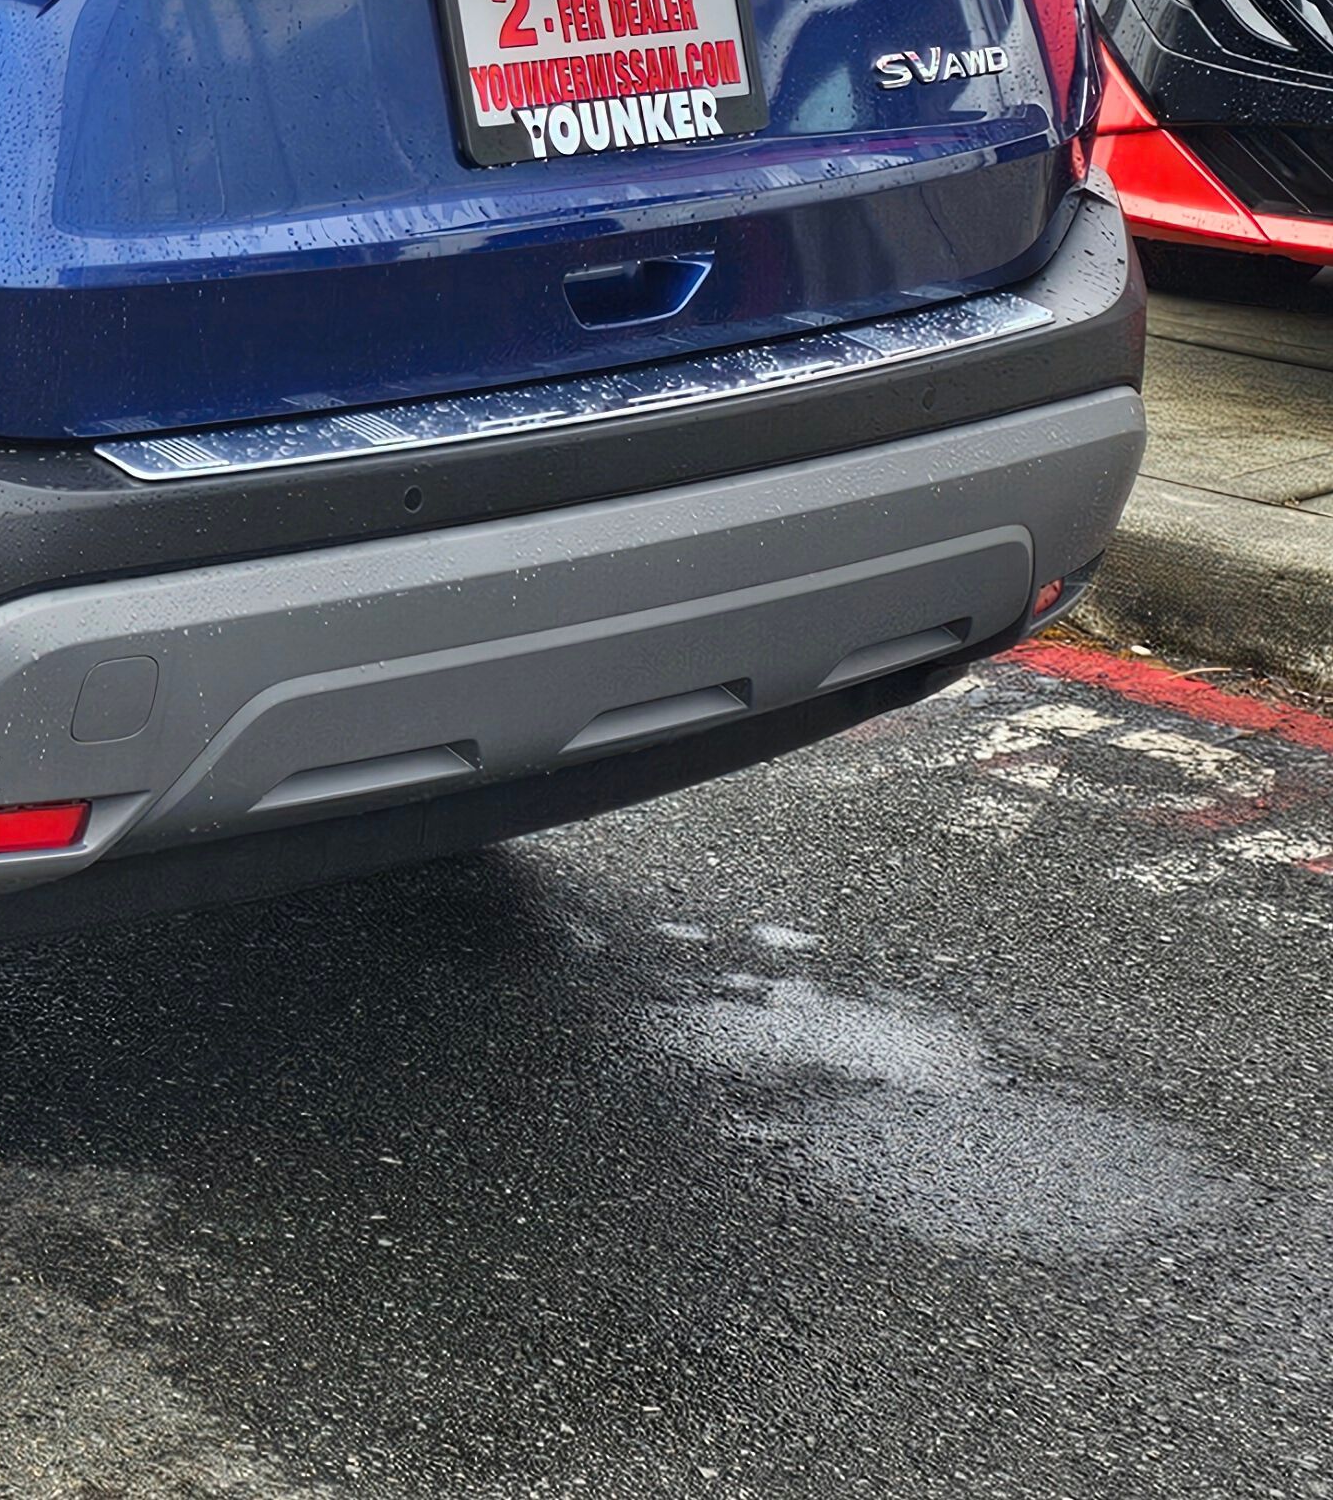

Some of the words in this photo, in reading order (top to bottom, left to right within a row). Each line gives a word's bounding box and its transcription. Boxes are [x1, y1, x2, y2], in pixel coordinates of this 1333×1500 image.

[469, 39, 741, 113] YOUNKERNISSAN.COM
[875, 46, 941, 89] SV
[943, 46, 1009, 81] AWD
[517, 88, 723, 159] YOUNKER
